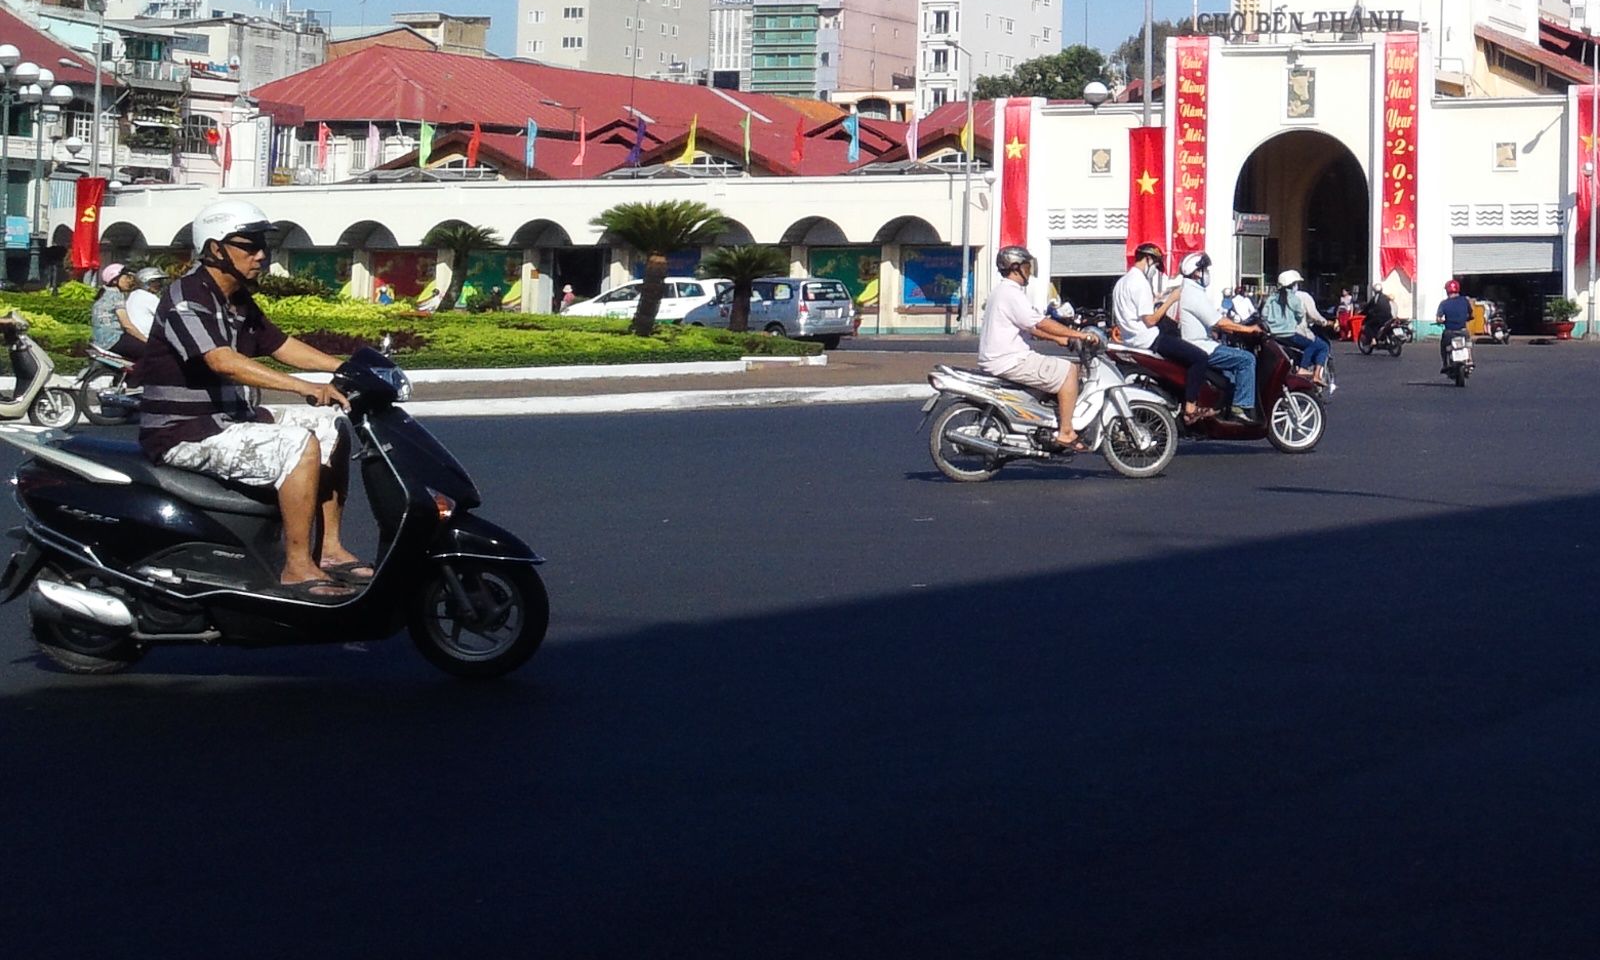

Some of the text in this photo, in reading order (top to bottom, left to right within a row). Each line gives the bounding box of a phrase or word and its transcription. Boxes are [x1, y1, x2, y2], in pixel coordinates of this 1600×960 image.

[1197, 12, 1247, 38] CHỢ
[1256, 5, 1304, 33] BẾN
[1387, 48, 1415, 74] Happy
[1388, 80, 1412, 99] New
[1386, 108, 1412, 133] Year
[1177, 221, 1199, 235] 2013
